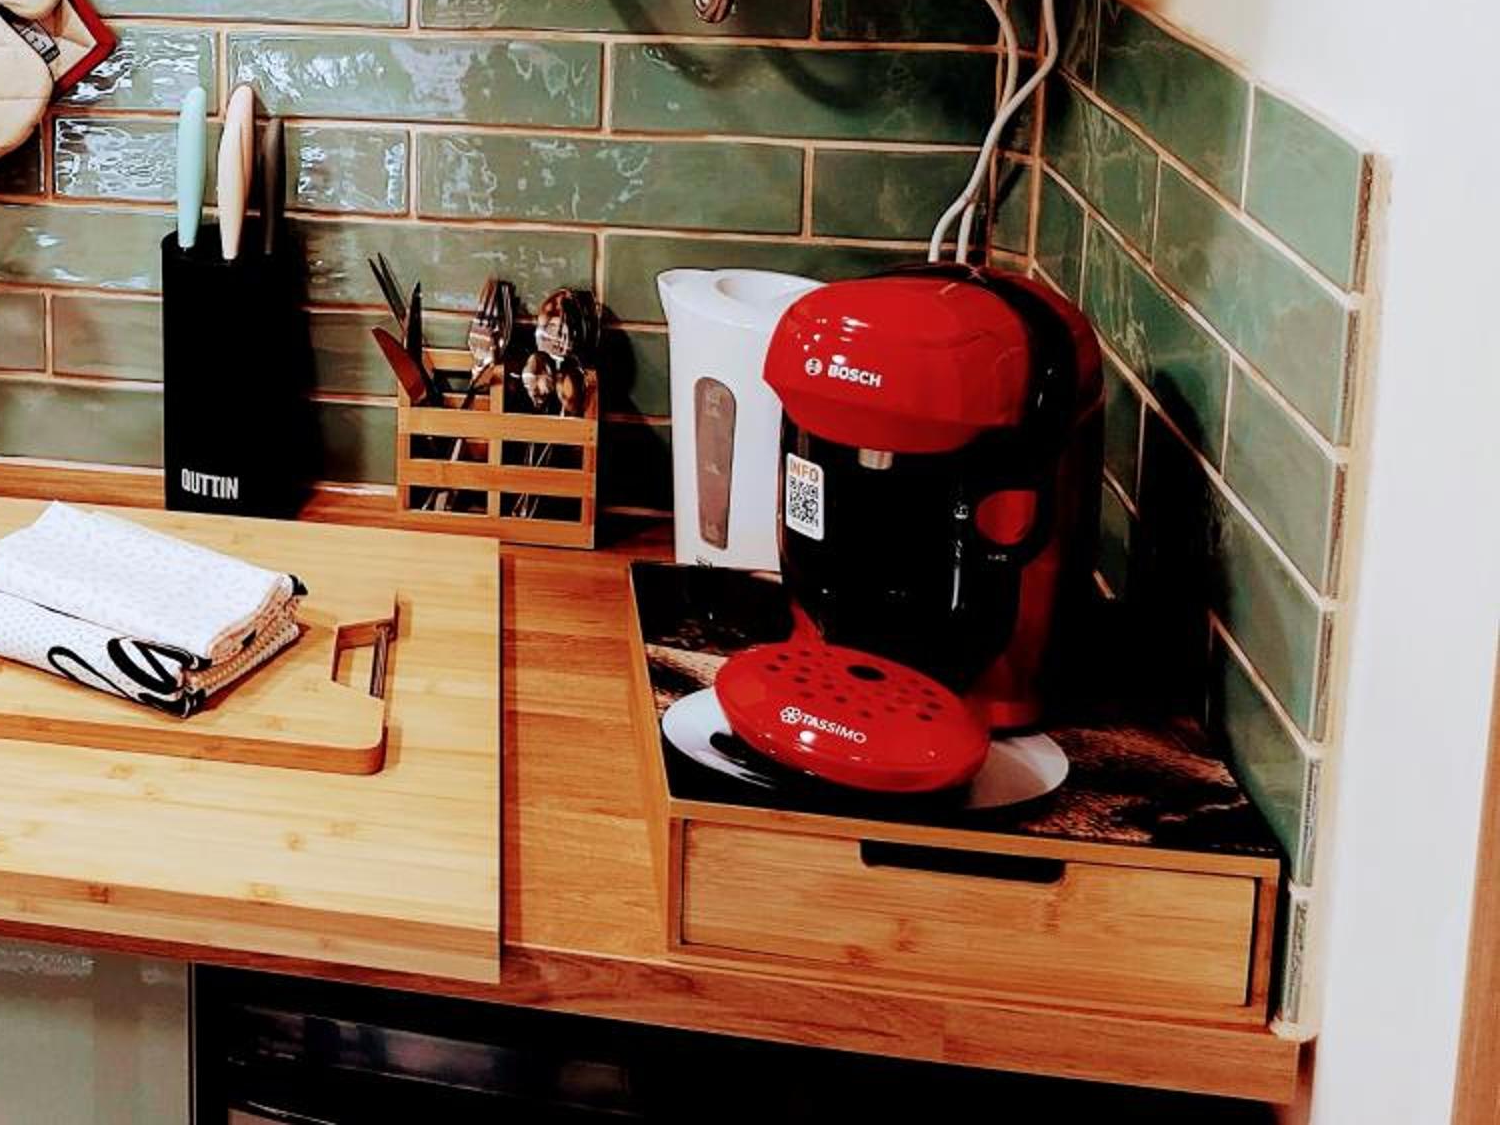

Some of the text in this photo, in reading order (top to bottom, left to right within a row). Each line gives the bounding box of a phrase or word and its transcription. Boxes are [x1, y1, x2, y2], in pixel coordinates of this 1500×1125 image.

[827, 363, 883, 388] BOSCH
[181, 468, 239, 500] QUTTIN
[789, 459, 819, 483] INFO
[801, 713, 868, 744] TASSIMO
